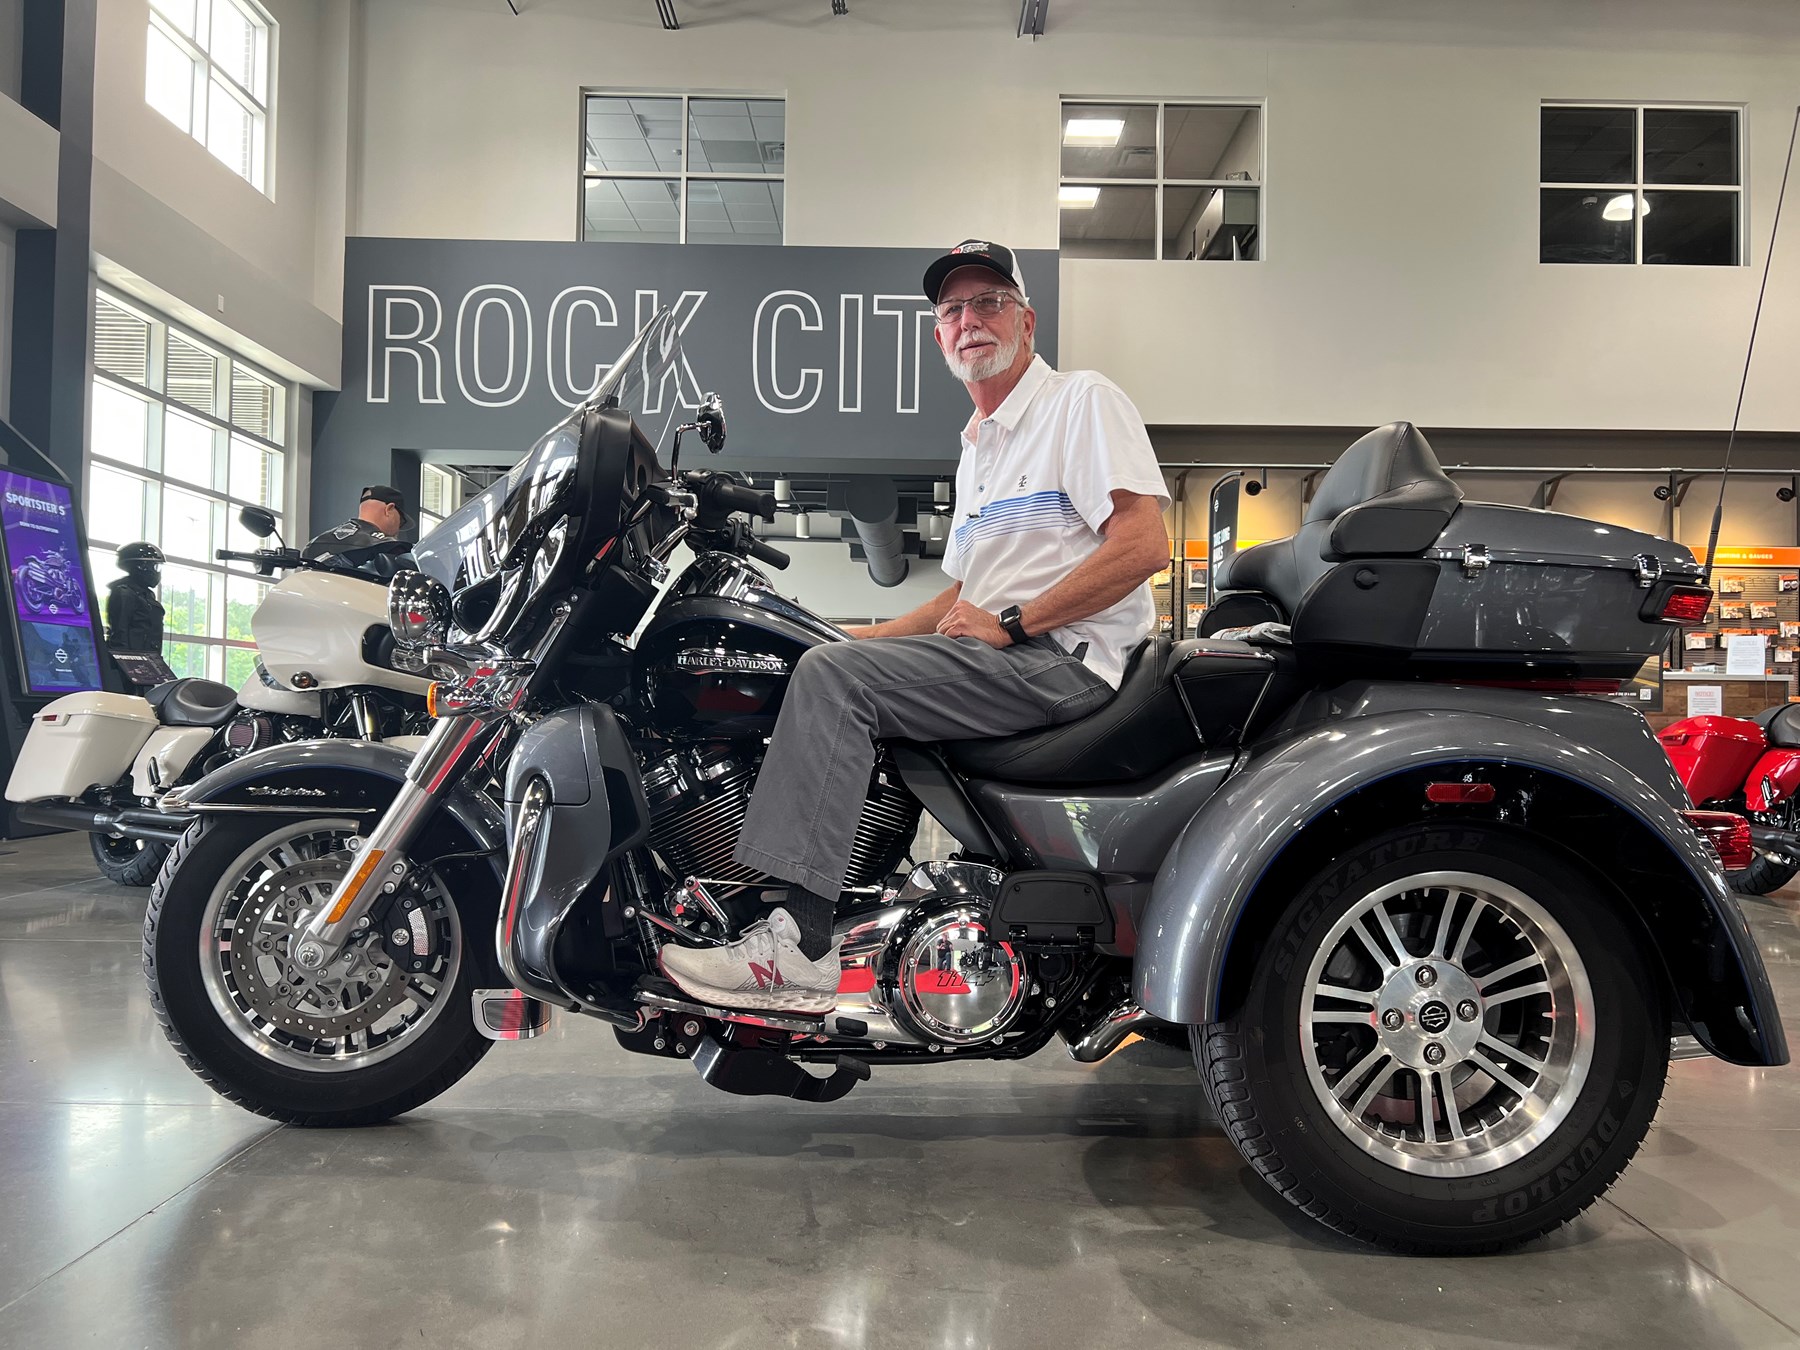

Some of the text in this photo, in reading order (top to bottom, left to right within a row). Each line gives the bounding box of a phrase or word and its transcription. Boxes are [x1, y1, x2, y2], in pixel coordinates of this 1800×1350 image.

[366, 283, 1030, 415] ROCK CIT
[5, 492, 66, 516] SPORTSTER S
[677, 654, 783, 671] HARLEY-DAVIDSON
[1274, 831, 1486, 982] SIGNATURE
[937, 969, 996, 987] 114
[1471, 1106, 1620, 1223] DUNLOP
